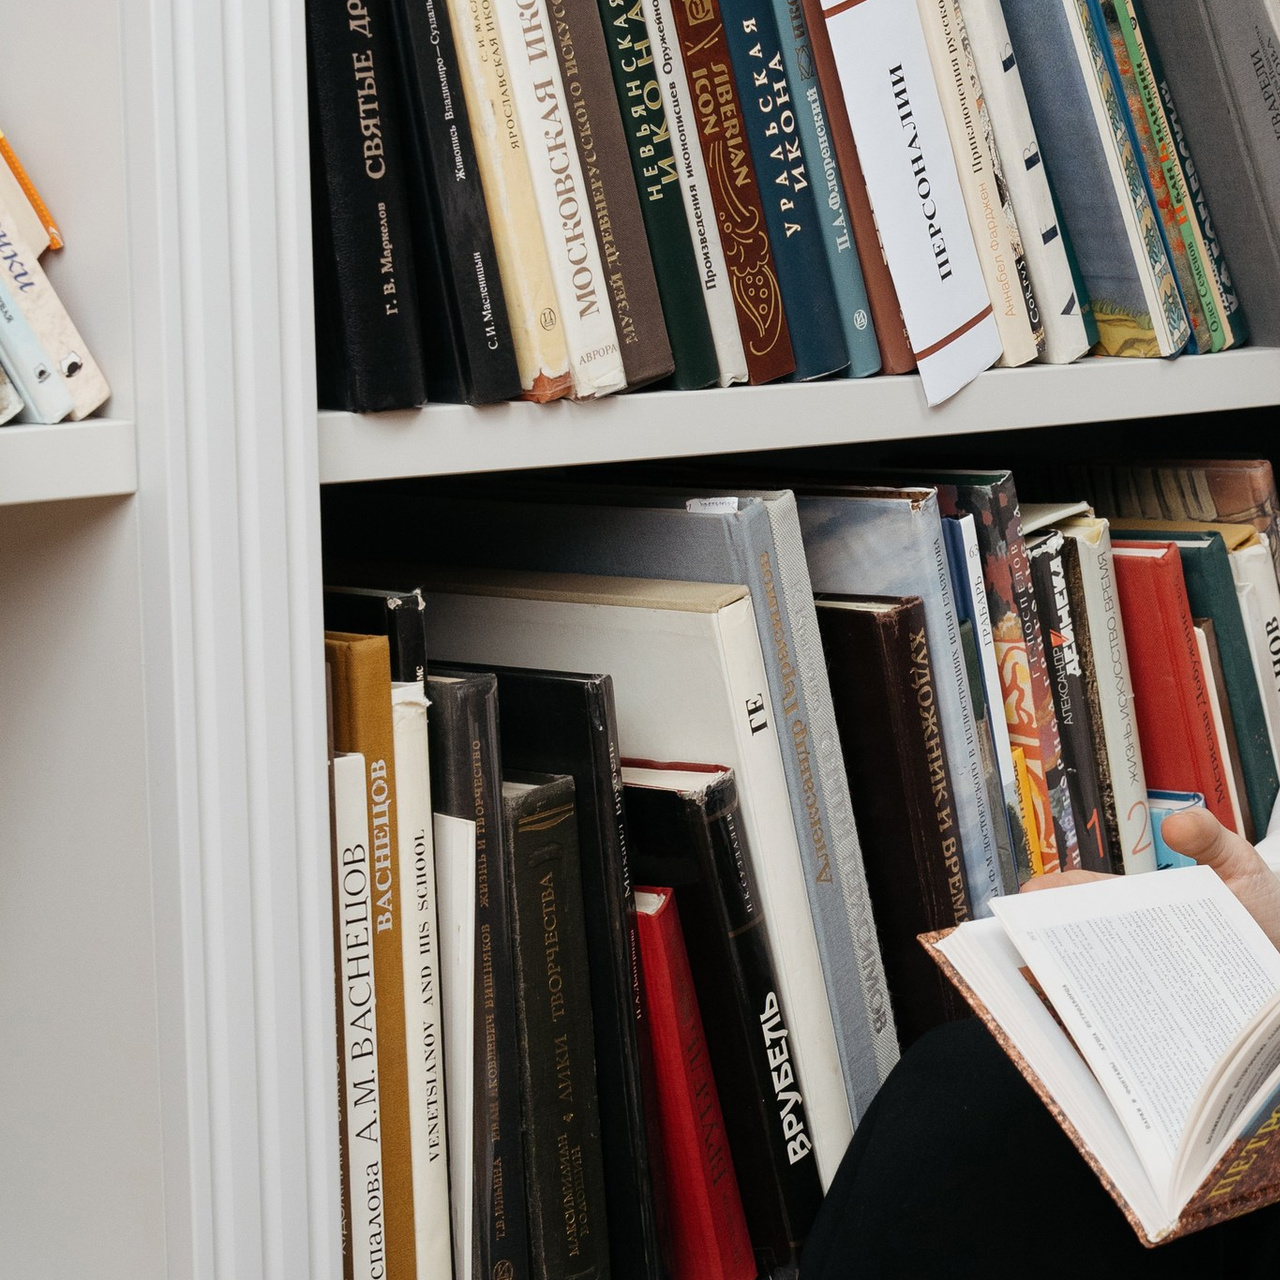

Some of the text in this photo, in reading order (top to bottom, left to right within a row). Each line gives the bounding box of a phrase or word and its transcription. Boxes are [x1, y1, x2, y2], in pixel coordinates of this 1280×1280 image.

[351, 50, 386, 181] СВЯТЫЕ
[490, 36, 521, 151] ЯРОСЛАВСКАЯ
[669, 81, 694, 179] иконописцев
[691, 68, 720, 136] ICON
[711, 62, 752, 188] SIBERIAN
[742, 17, 801, 239] УРАЛЬСКАЯ
[768, 50, 808, 194] ИКОНА
[950, 51, 983, 175] Приключения
[450, 124, 466, 183] Живопись
[532, 76, 601, 320] МОСКОВСКАЯ
[888, 61, 955, 283] ПЕРСОНАЛИИ
[376, 202, 395, 273] Маркелов
[688, 183, 717, 291] Произведения
[978, 180, 1003, 251] Фарджен
[611, 268, 640, 345] МУЗЕЙ
[992, 253, 1018, 318] Аннабел
[1186, 241, 1210, 296] Семенов
[579, 342, 619, 366] АВРОРА
[974, 576, 991, 647] ГРАБАРЬ
[745, 691, 768, 737] ГЕ
[908, 626, 951, 806] ХУДОЖНИК
[1052, 646, 1074, 726] АЛЕКСАНДР
[472, 739, 486, 841] ТВОРЧЕСТВО
[1085, 807, 1105, 859] 1
[1126, 801, 1152, 856] 2
[370, 759, 394, 935] ВАСНЕЦОВ
[342, 841, 374, 1062] ВАСНЕЦОВ
[413, 828, 441, 1163] VENETSIANOV AND HIS SCHOOL
[542, 871, 566, 1022] ТВОРЧЕСТВА
[759, 990, 812, 1166] ВРУБЕЛЬ
